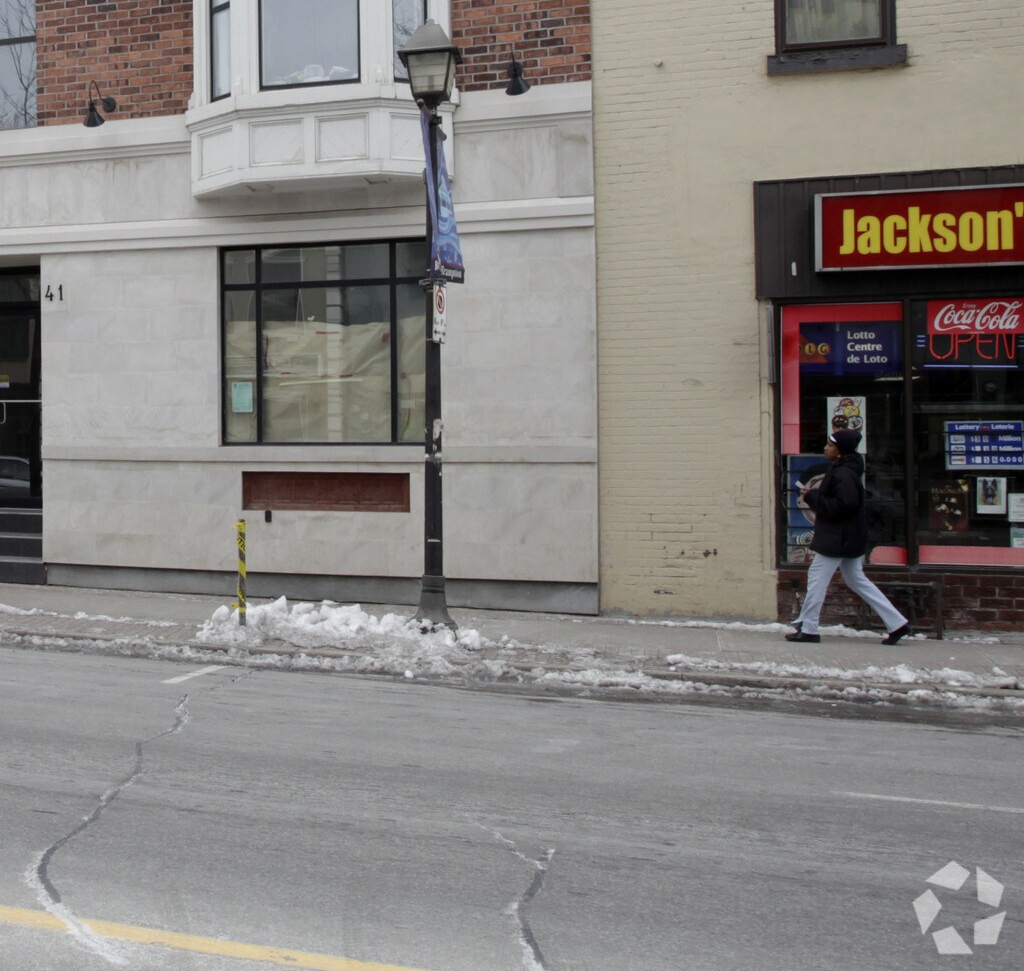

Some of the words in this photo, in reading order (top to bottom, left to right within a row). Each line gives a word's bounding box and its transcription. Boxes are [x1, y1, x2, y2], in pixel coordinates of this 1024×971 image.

[45, 284, 64, 302] 41
[847, 331, 876, 340] Lotto
[847, 343, 883, 352] Centre
[929, 333, 1016, 360] OPEN
[847, 354, 860, 364] de
[864, 354, 888, 364] Loto
[955, 424, 981, 432] Lottery
